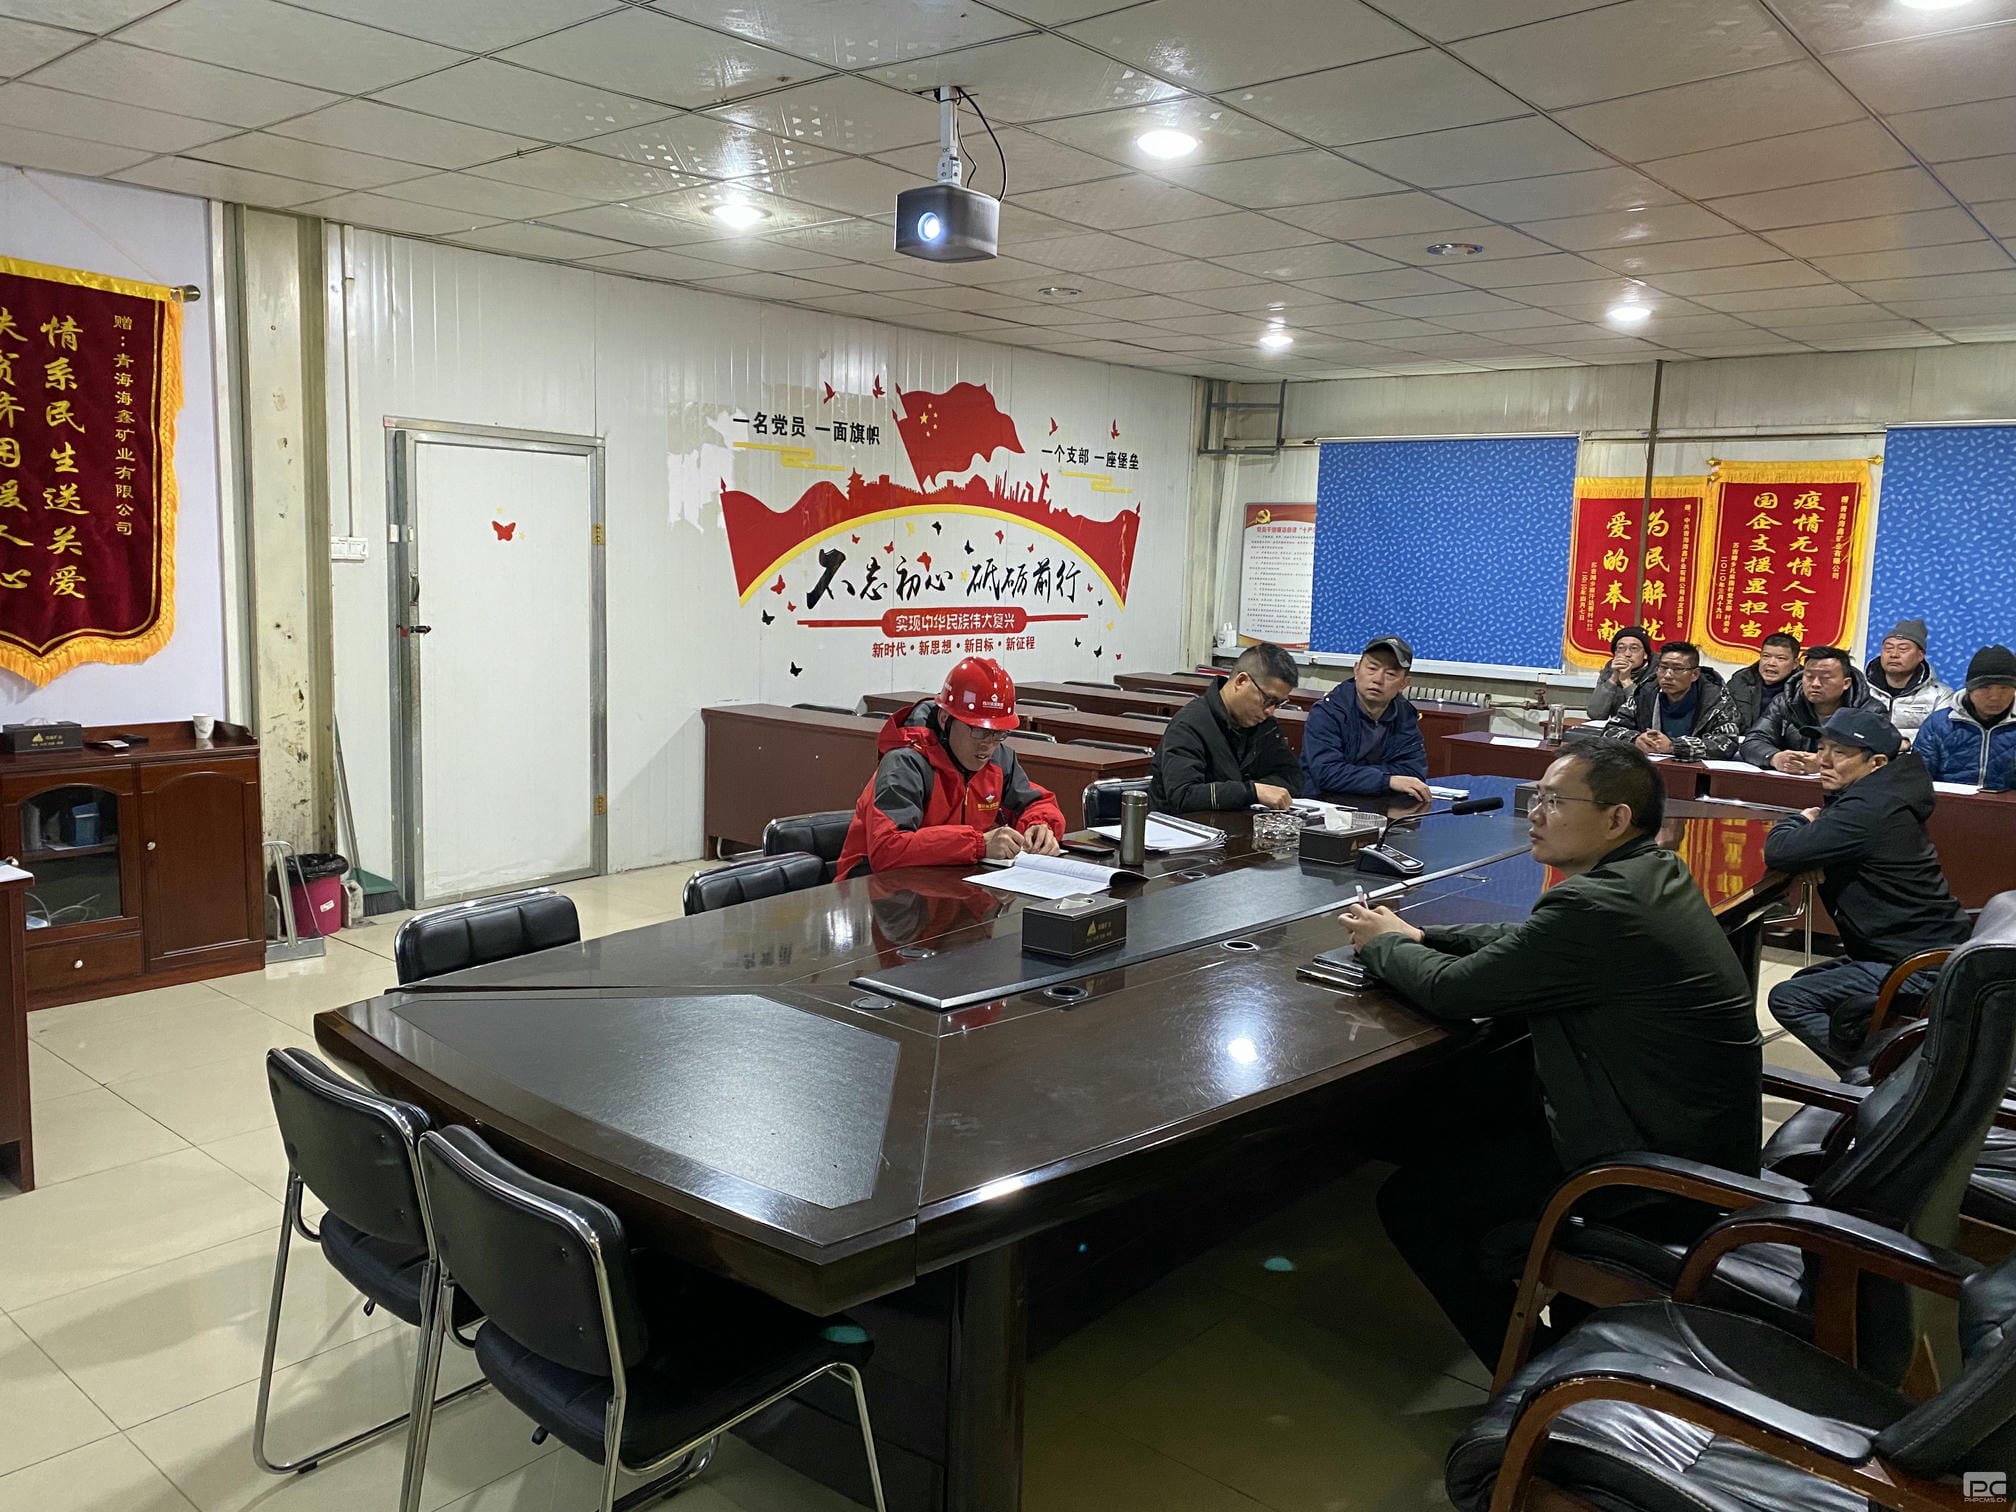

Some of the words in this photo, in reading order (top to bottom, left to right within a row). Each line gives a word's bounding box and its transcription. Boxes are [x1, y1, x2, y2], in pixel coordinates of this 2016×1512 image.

[40, 314, 90, 599] 情系民生送关爱
[733, 411, 806, 439] 一名党员
[815, 422, 881, 446] 一面旗帜
[1041, 443, 1090, 465] 一个支部
[1094, 451, 1139, 470] 一座堡垒
[806, 548, 952, 610] 不忘初心
[966, 556, 1082, 604] 砥砺前行
[1738, 492, 1782, 638] 国企支援显担当
[1778, 490, 1826, 643] 疫情无情人有情
[895, 613, 1016, 632] 实现中华民族伟大复兴
